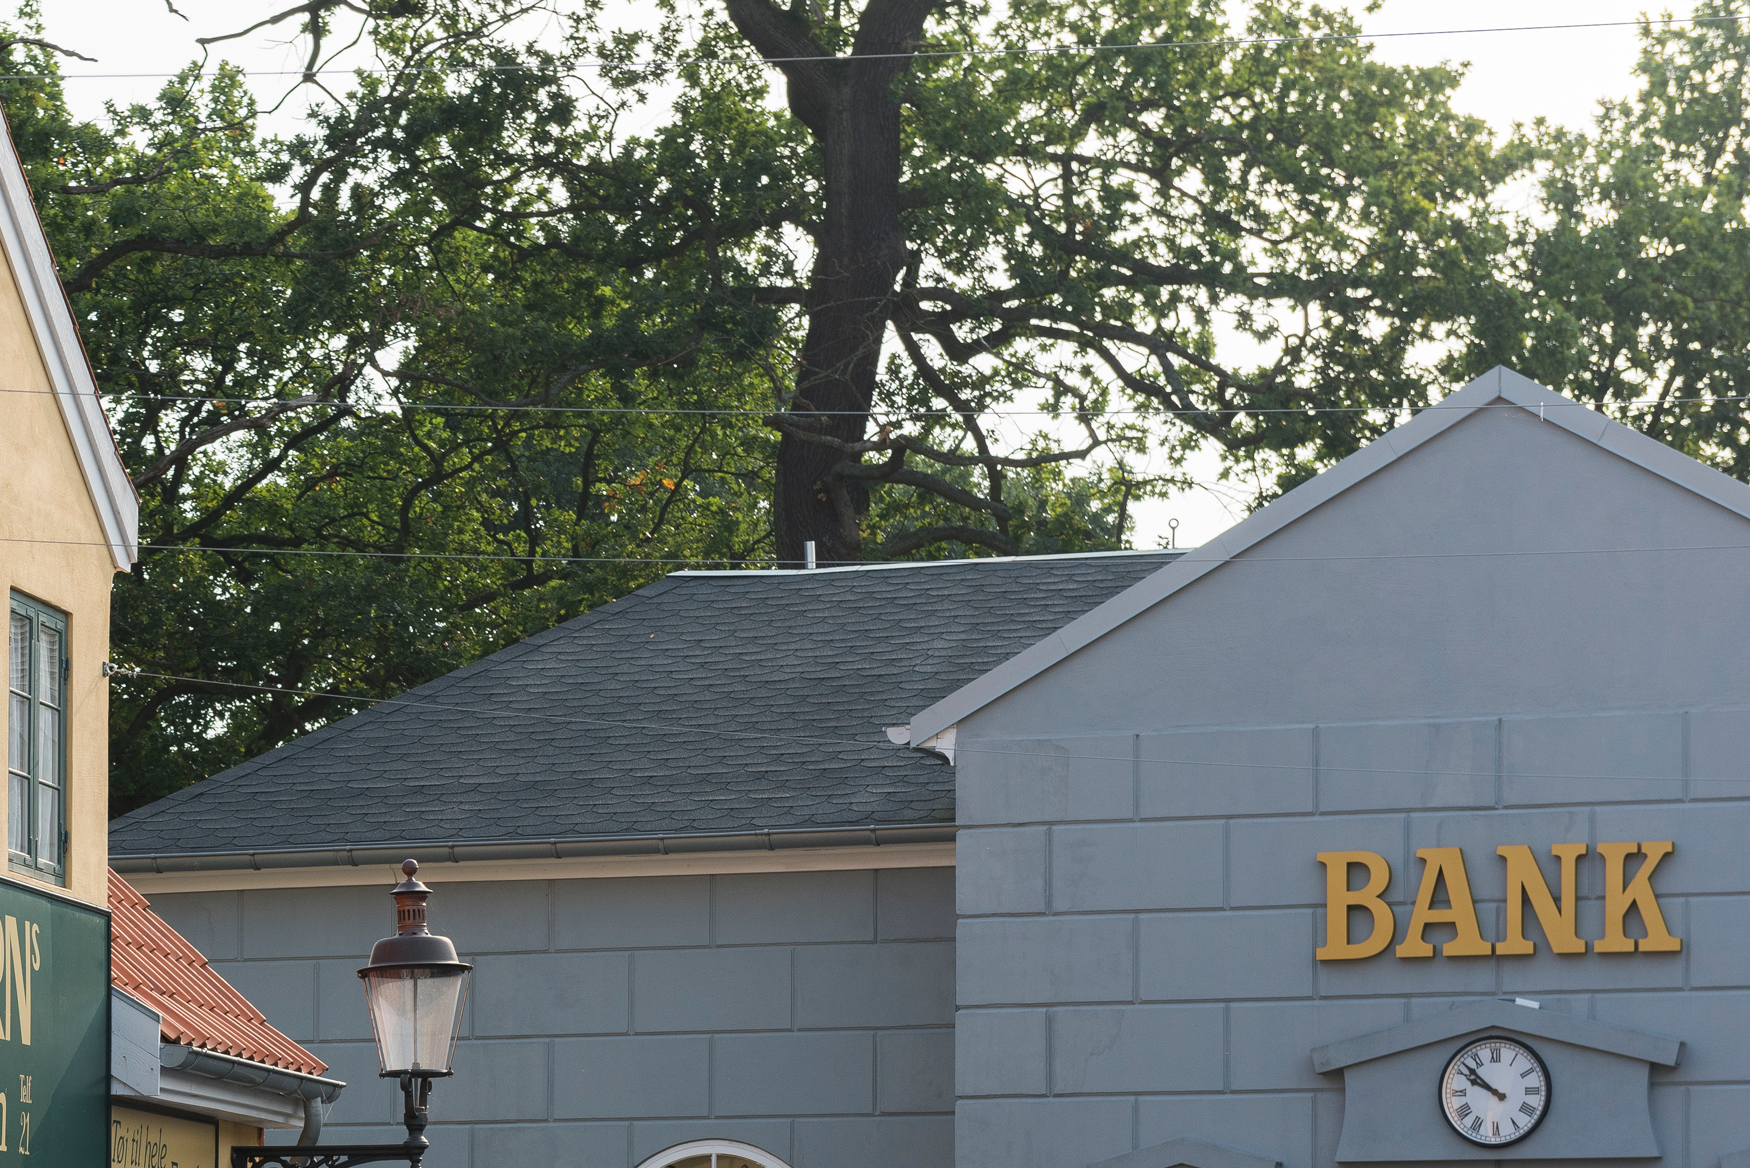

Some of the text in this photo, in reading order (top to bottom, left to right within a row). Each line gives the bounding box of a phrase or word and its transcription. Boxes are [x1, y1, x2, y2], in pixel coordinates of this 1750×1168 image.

[1315, 840, 1683, 961] BANK
[1470, 1052, 1484, 1070] XI
[1489, 1048, 1501, 1063] XII
[1520, 1067, 1535, 1079] II
[1524, 1086, 1539, 1096] III
[19, 1111, 30, 1155] 21
[131, 1124, 143, 1167] til
